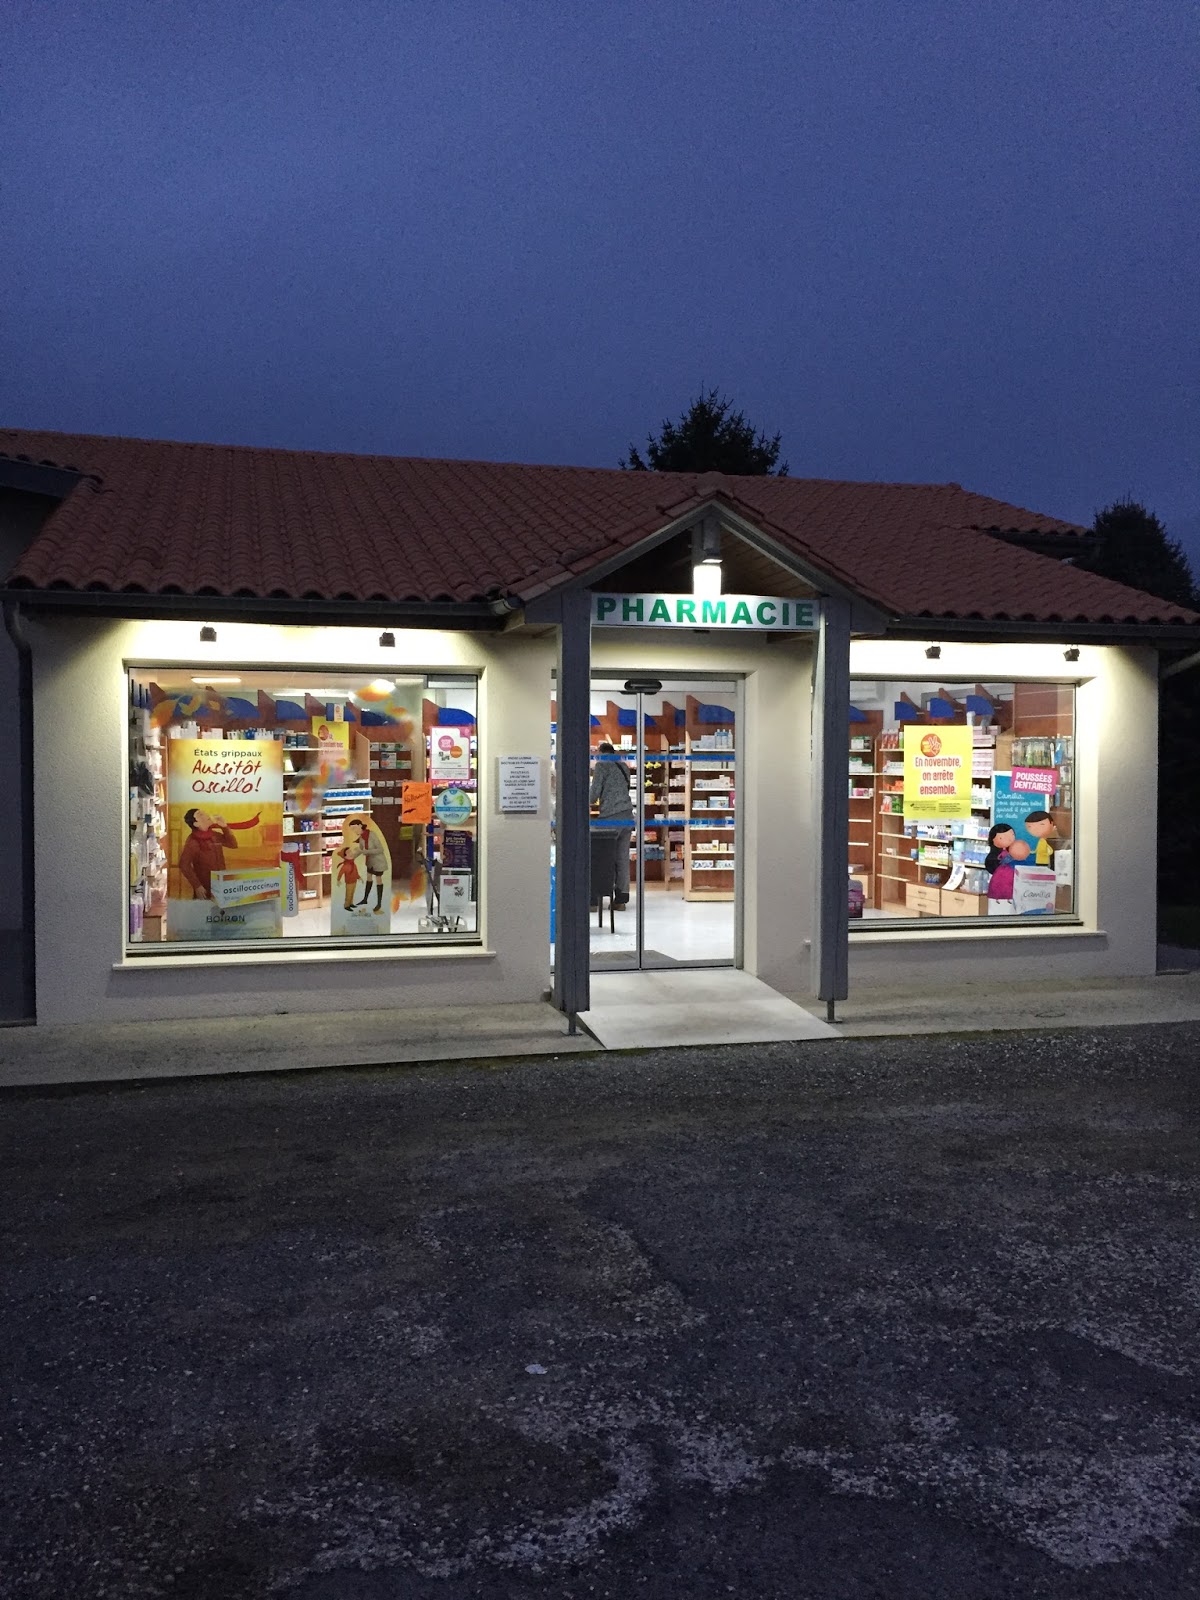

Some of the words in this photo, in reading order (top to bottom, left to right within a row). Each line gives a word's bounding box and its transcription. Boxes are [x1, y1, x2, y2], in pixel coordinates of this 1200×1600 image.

[596, 597, 814, 627] PHARMACIE
[194, 749, 219, 757] États
[221, 750, 262, 758] grippaux
[192, 759, 262, 775] Aussitôt
[915, 757, 923, 767] En
[924, 757, 961, 768] novembre,
[922, 772, 931, 781] on
[932, 769, 954, 781] arrête
[1015, 771, 1053, 784] POUSSÉES
[919, 785, 957, 795] ensemble.
[1013, 781, 1052, 792] DENTAIRES
[223, 882, 280, 895] oscillococcinum
